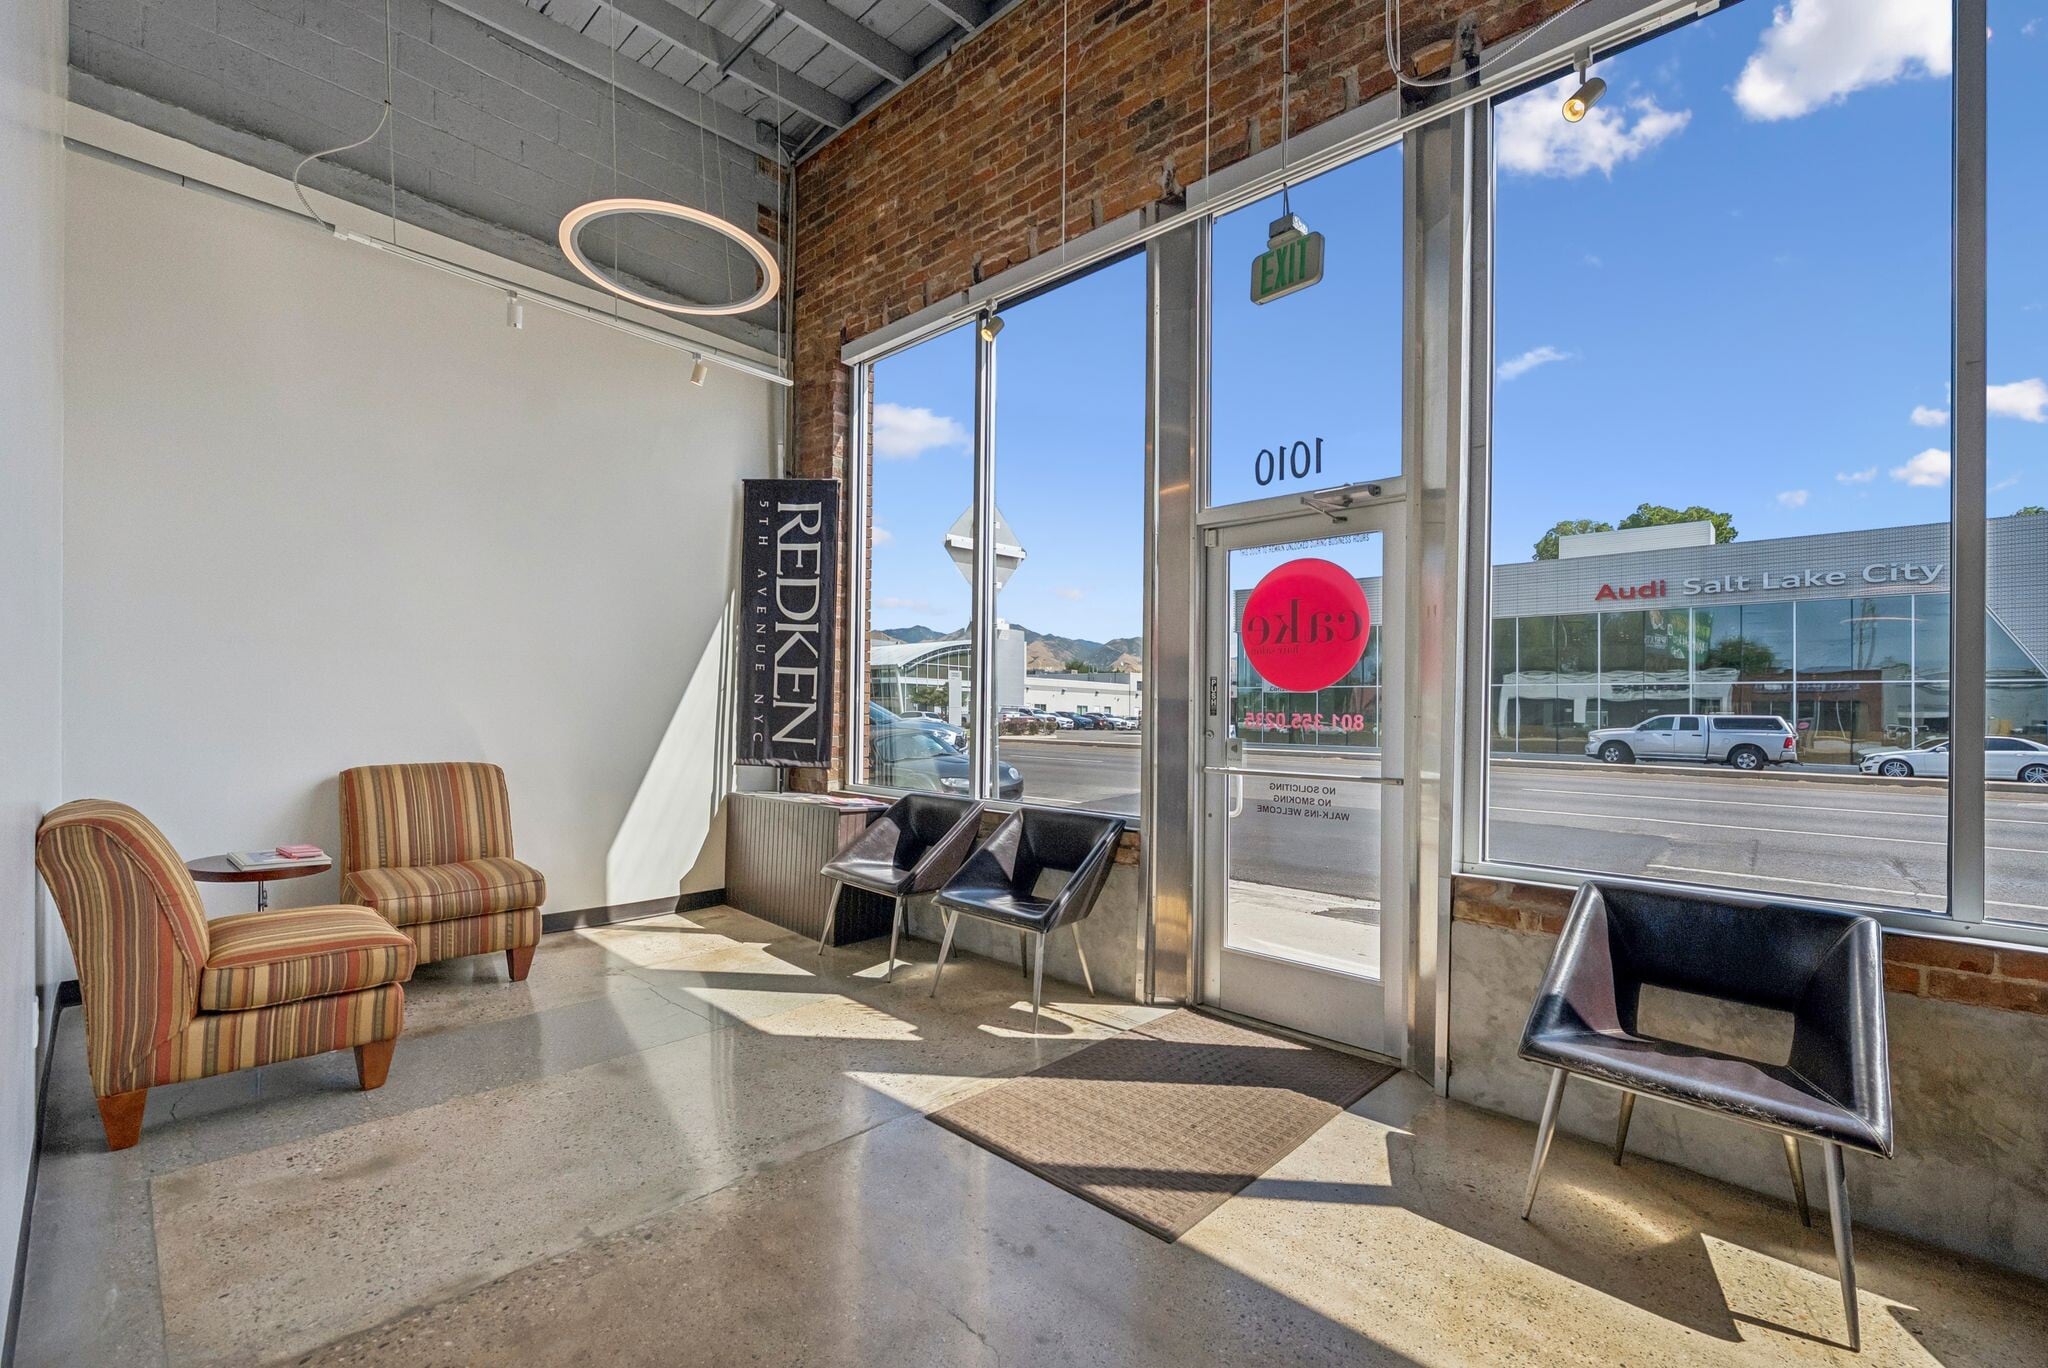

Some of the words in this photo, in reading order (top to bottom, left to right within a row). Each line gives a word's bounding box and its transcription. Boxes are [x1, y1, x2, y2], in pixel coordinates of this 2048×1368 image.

[1260, 236, 1312, 295] EXIT
[758, 500, 769, 546] 5TH
[1595, 579, 1667, 601] Audi
[1682, 575, 1750, 596] Salt
[1763, 569, 1847, 590] Lake
[1862, 563, 1944, 585] City
[754, 568, 768, 672] AVENUE
[772, 501, 822, 746] REDKEN
[752, 693, 765, 742] NYC
